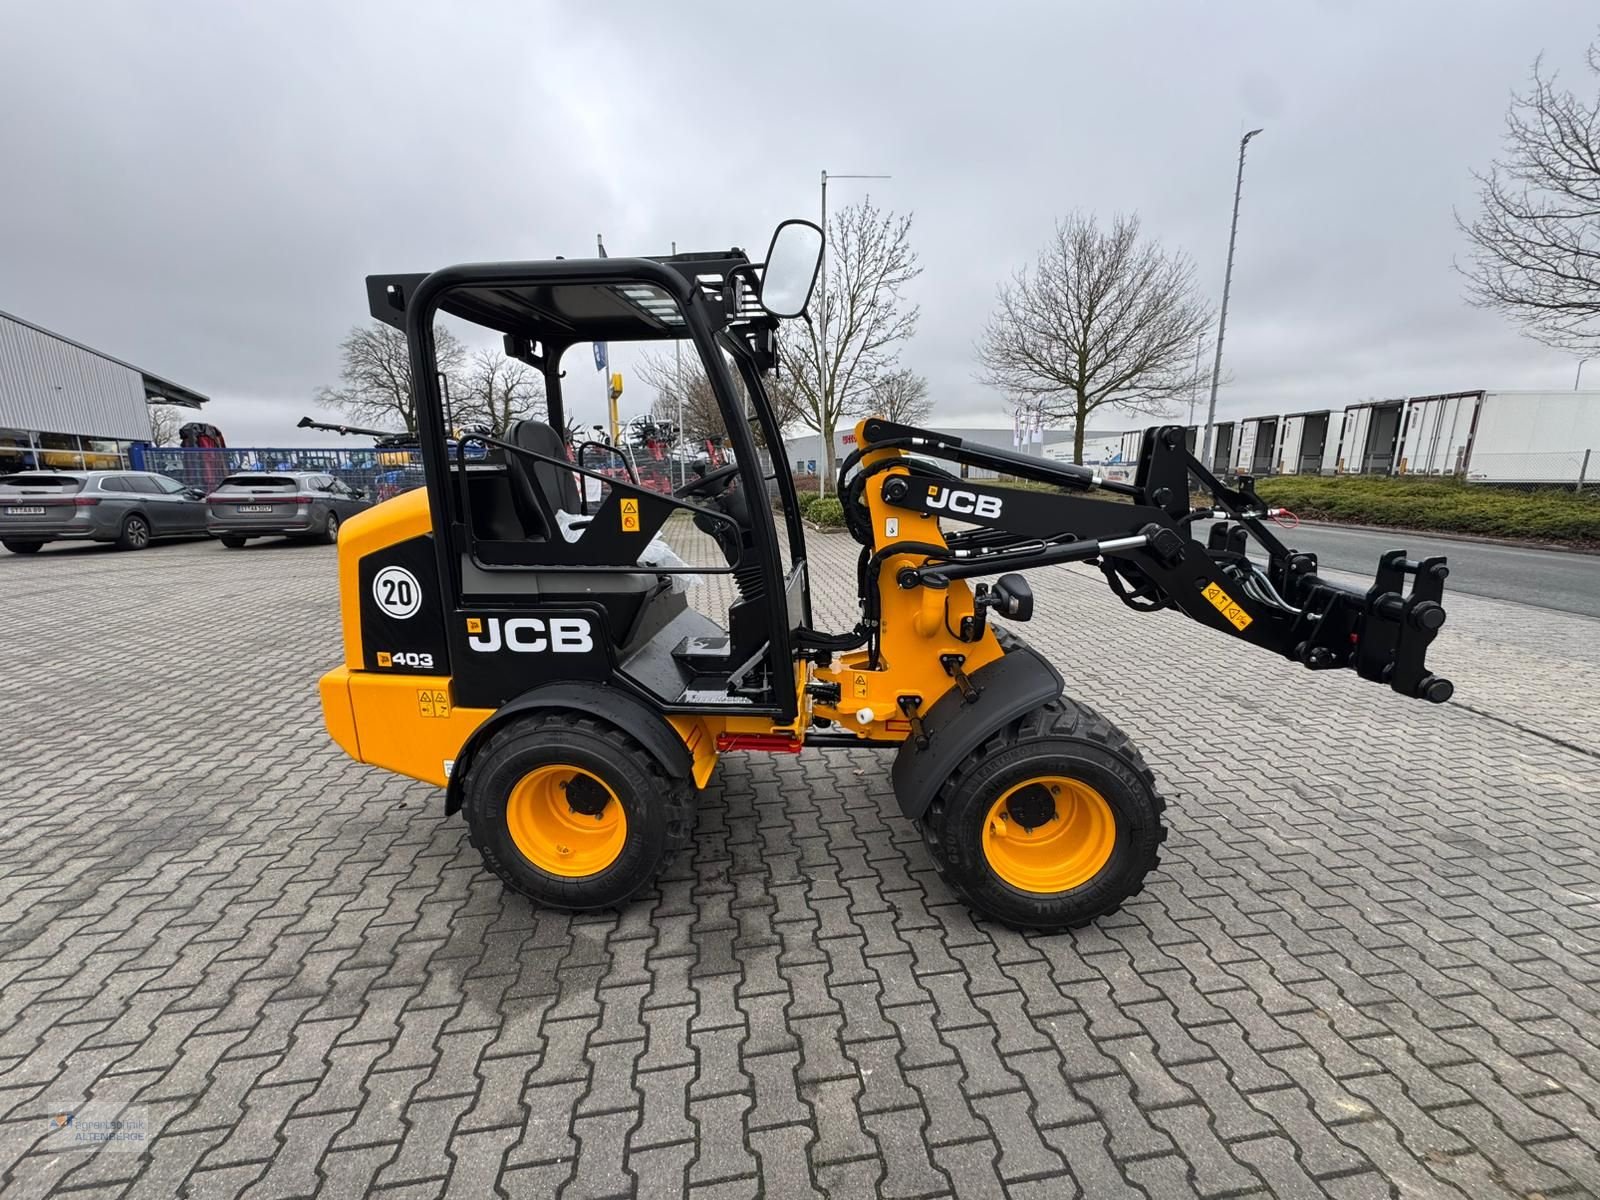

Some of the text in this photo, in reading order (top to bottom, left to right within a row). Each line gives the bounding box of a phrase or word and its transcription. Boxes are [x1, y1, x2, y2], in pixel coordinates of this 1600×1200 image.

[926, 487, 1003, 519] JCB
[382, 579, 412, 606] 20
[468, 617, 594, 653] JCB
[392, 651, 434, 666] 403
